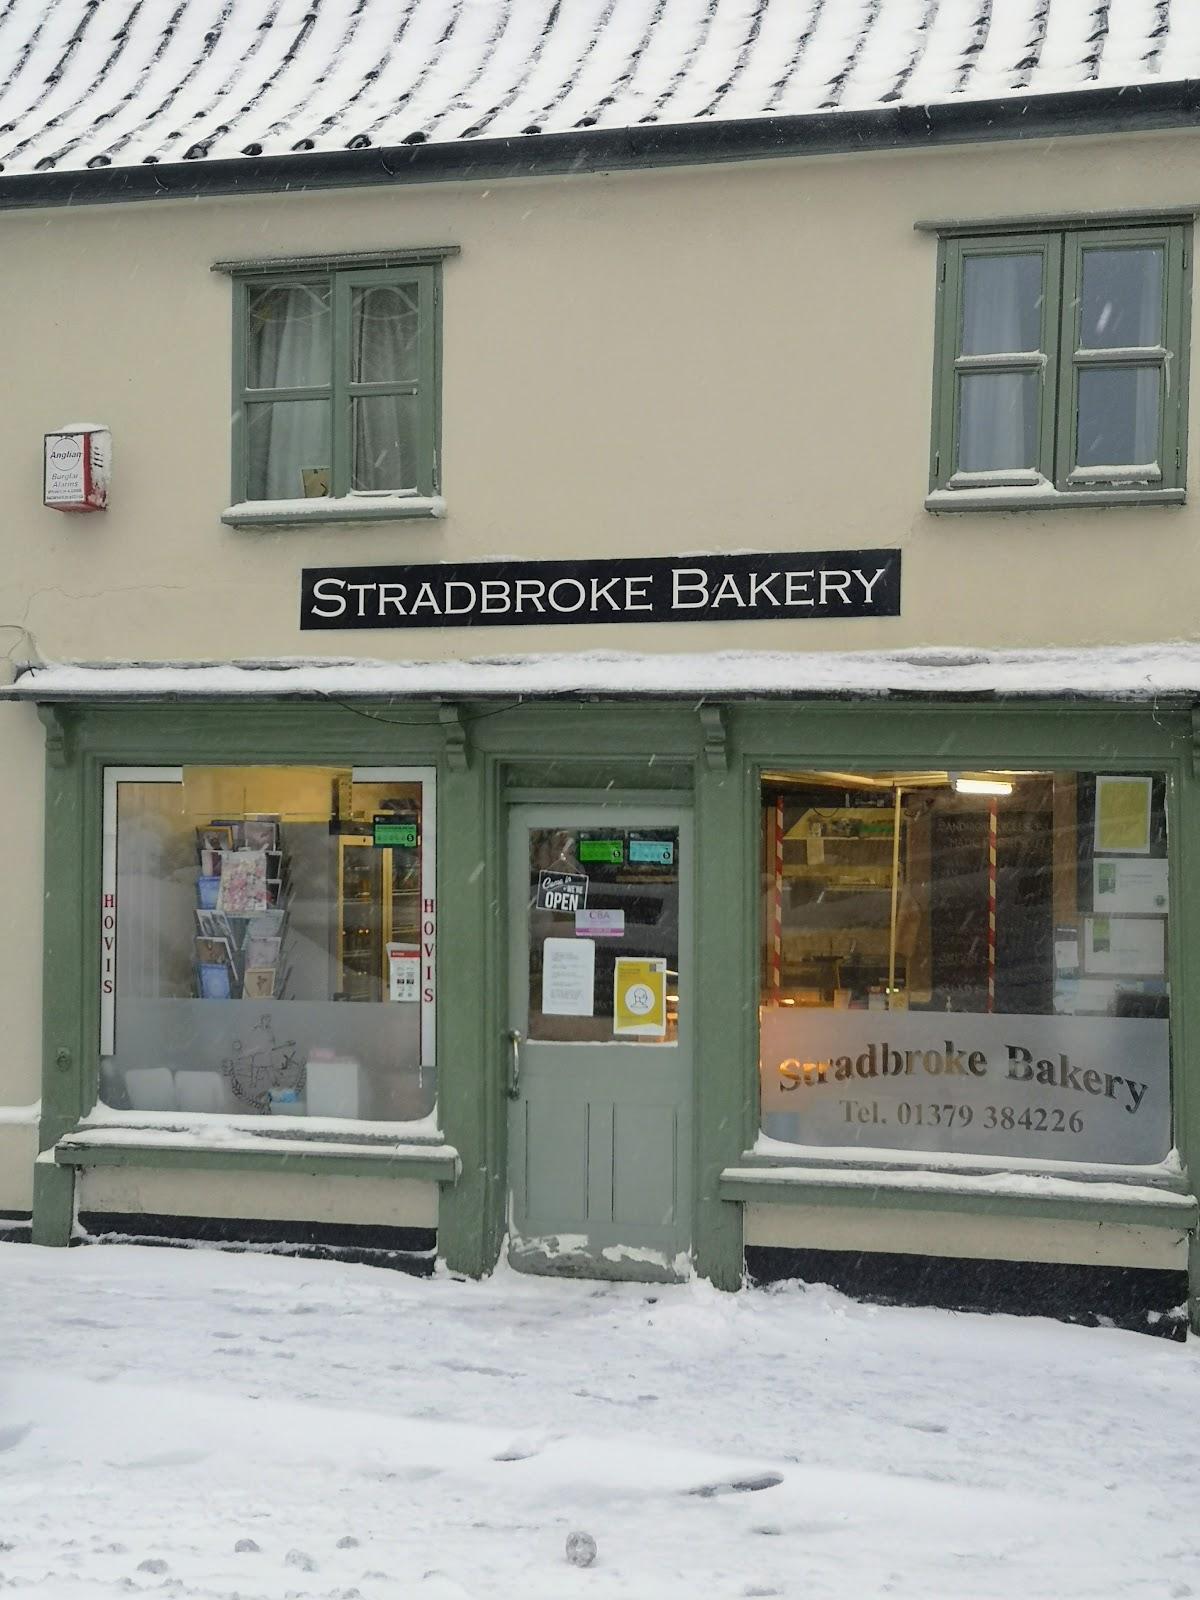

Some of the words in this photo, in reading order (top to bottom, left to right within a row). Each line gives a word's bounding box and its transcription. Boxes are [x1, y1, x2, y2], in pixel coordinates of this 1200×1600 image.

[50, 451, 81, 460] Anglian
[311, 577, 653, 617] STRADBROKE
[671, 568, 886, 611] BAKERY
[542, 877, 563, 889] Come
[565, 875, 572, 883] in
[545, 891, 579, 911] OPEN
[103, 894, 114, 994] HOVIS
[423, 899, 434, 1003] HOVIS
[778, 1040, 988, 1093] Stradbroke
[1005, 1044, 1149, 1115] Bakery
[840, 1100, 887, 1124] Tel.
[897, 1102, 974, 1128] 01379
[983, 1105, 1084, 1134] 384226
